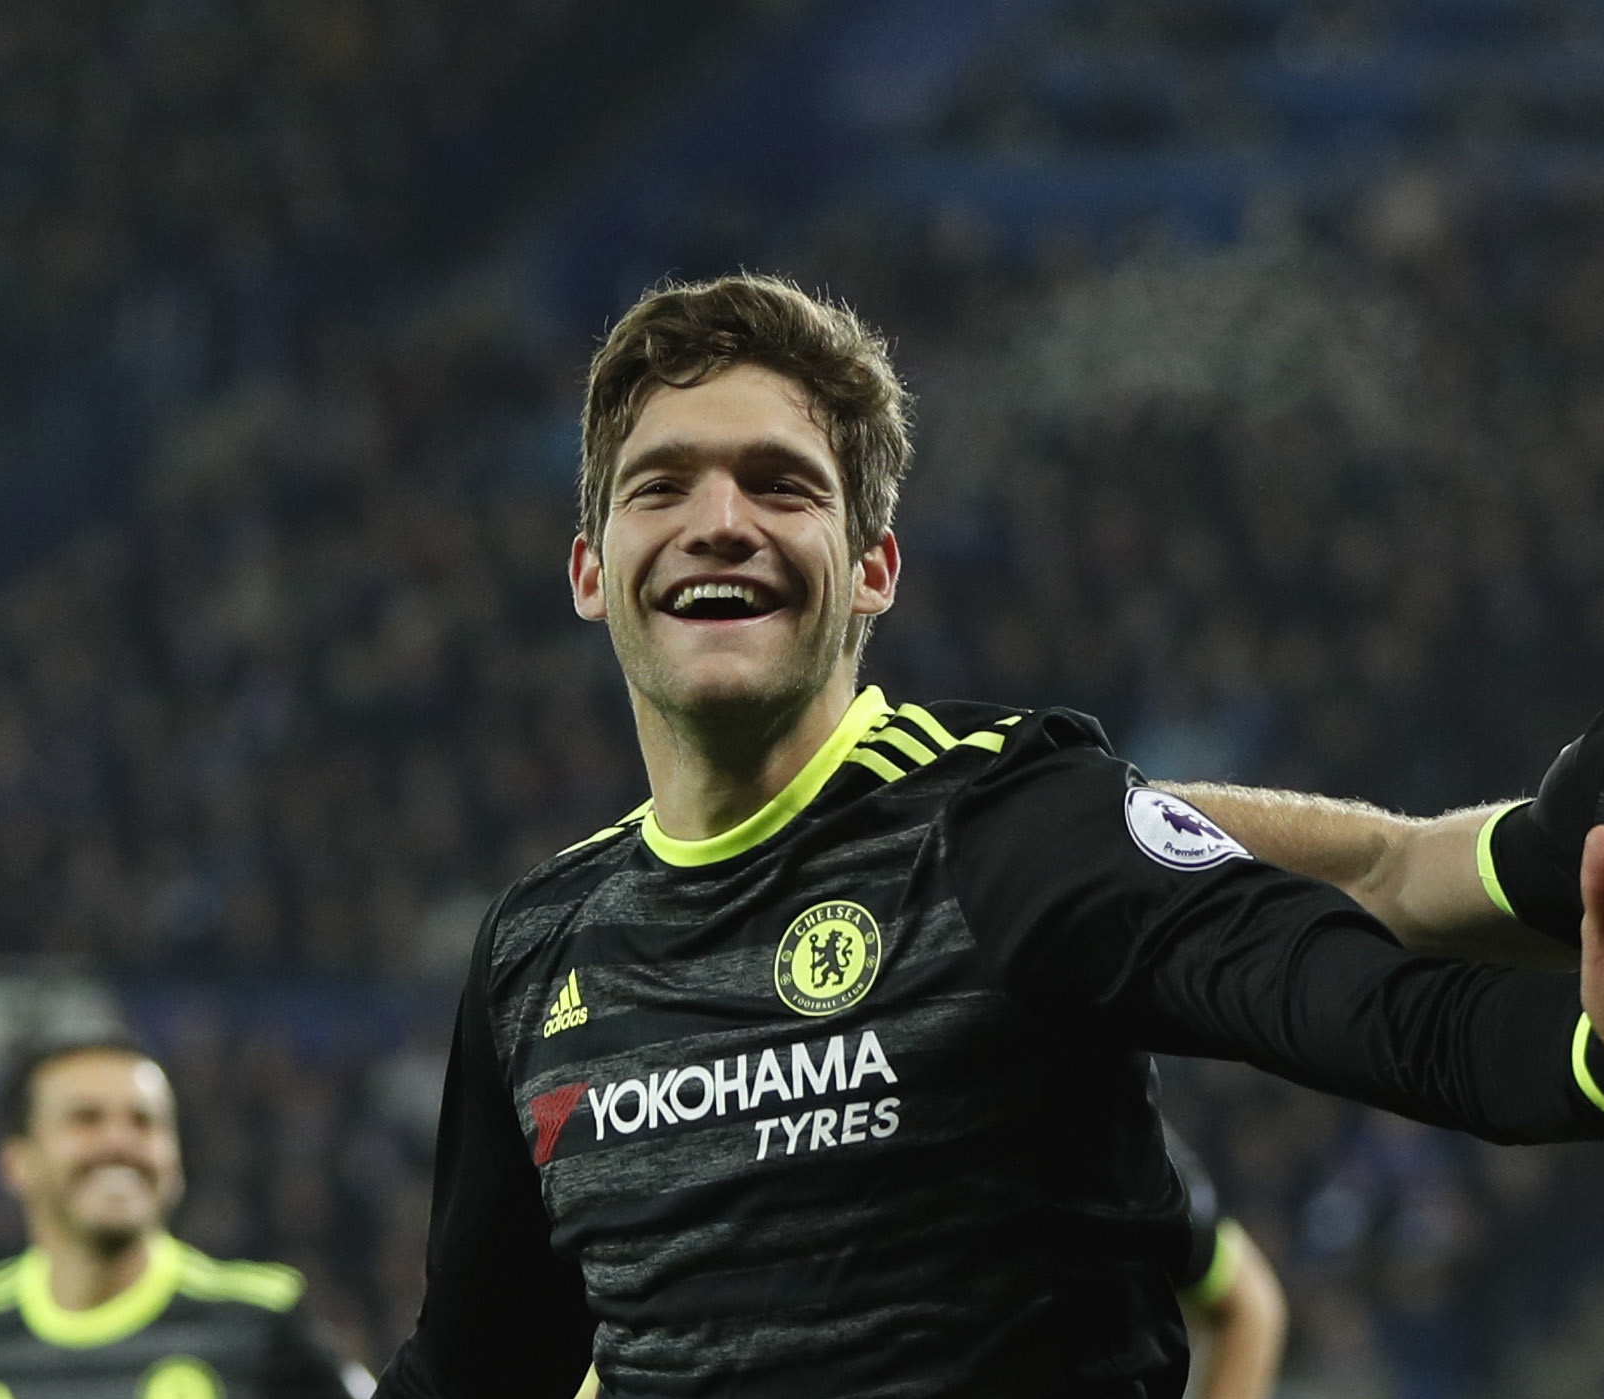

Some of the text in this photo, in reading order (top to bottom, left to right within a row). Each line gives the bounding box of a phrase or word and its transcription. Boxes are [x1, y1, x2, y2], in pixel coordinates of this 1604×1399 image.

[1163, 841, 1205, 857] Premier
[794, 905, 862, 937] CHELSEA
[543, 1006, 589, 1038] adidas
[587, 1029, 899, 1141] YOKOHAMA
[754, 1096, 902, 1162] TYRES
